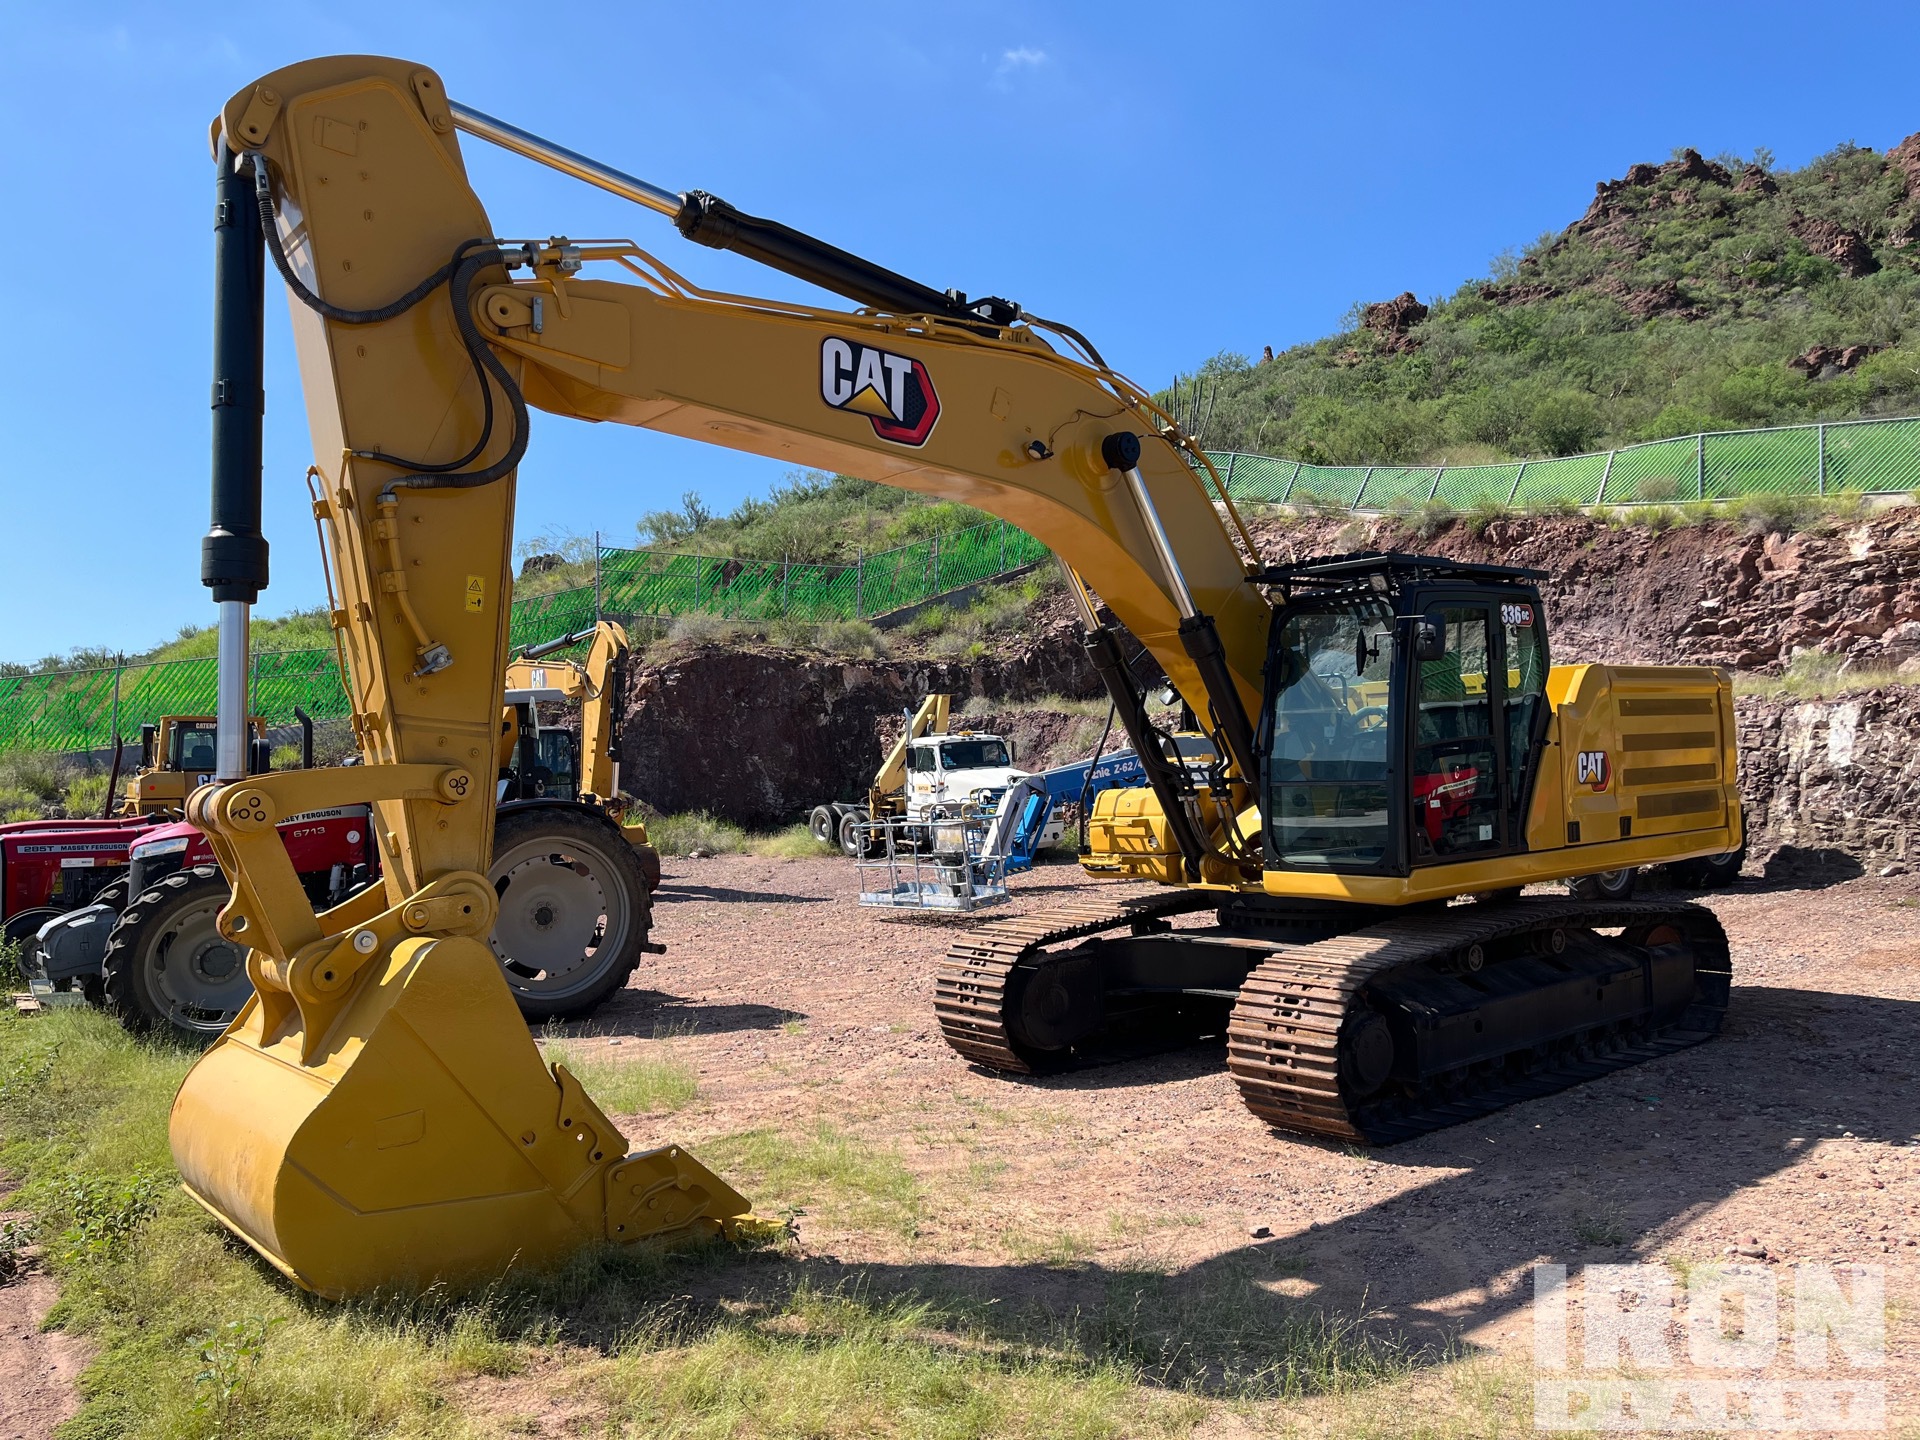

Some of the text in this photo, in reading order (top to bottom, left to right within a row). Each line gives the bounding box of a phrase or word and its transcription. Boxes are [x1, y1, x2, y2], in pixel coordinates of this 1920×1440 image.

[822, 337, 912, 422] CAT
[1501, 604, 1530, 624] 336 GC
[531, 669, 544, 689] CAT
[1114, 759, 1143, 775] Z-62/4
[1578, 752, 1604, 783] CAT
[275, 809, 342, 824] SSEY FERGUSON
[293, 826, 326, 838] 6713
[24, 845, 54, 853] 285T
